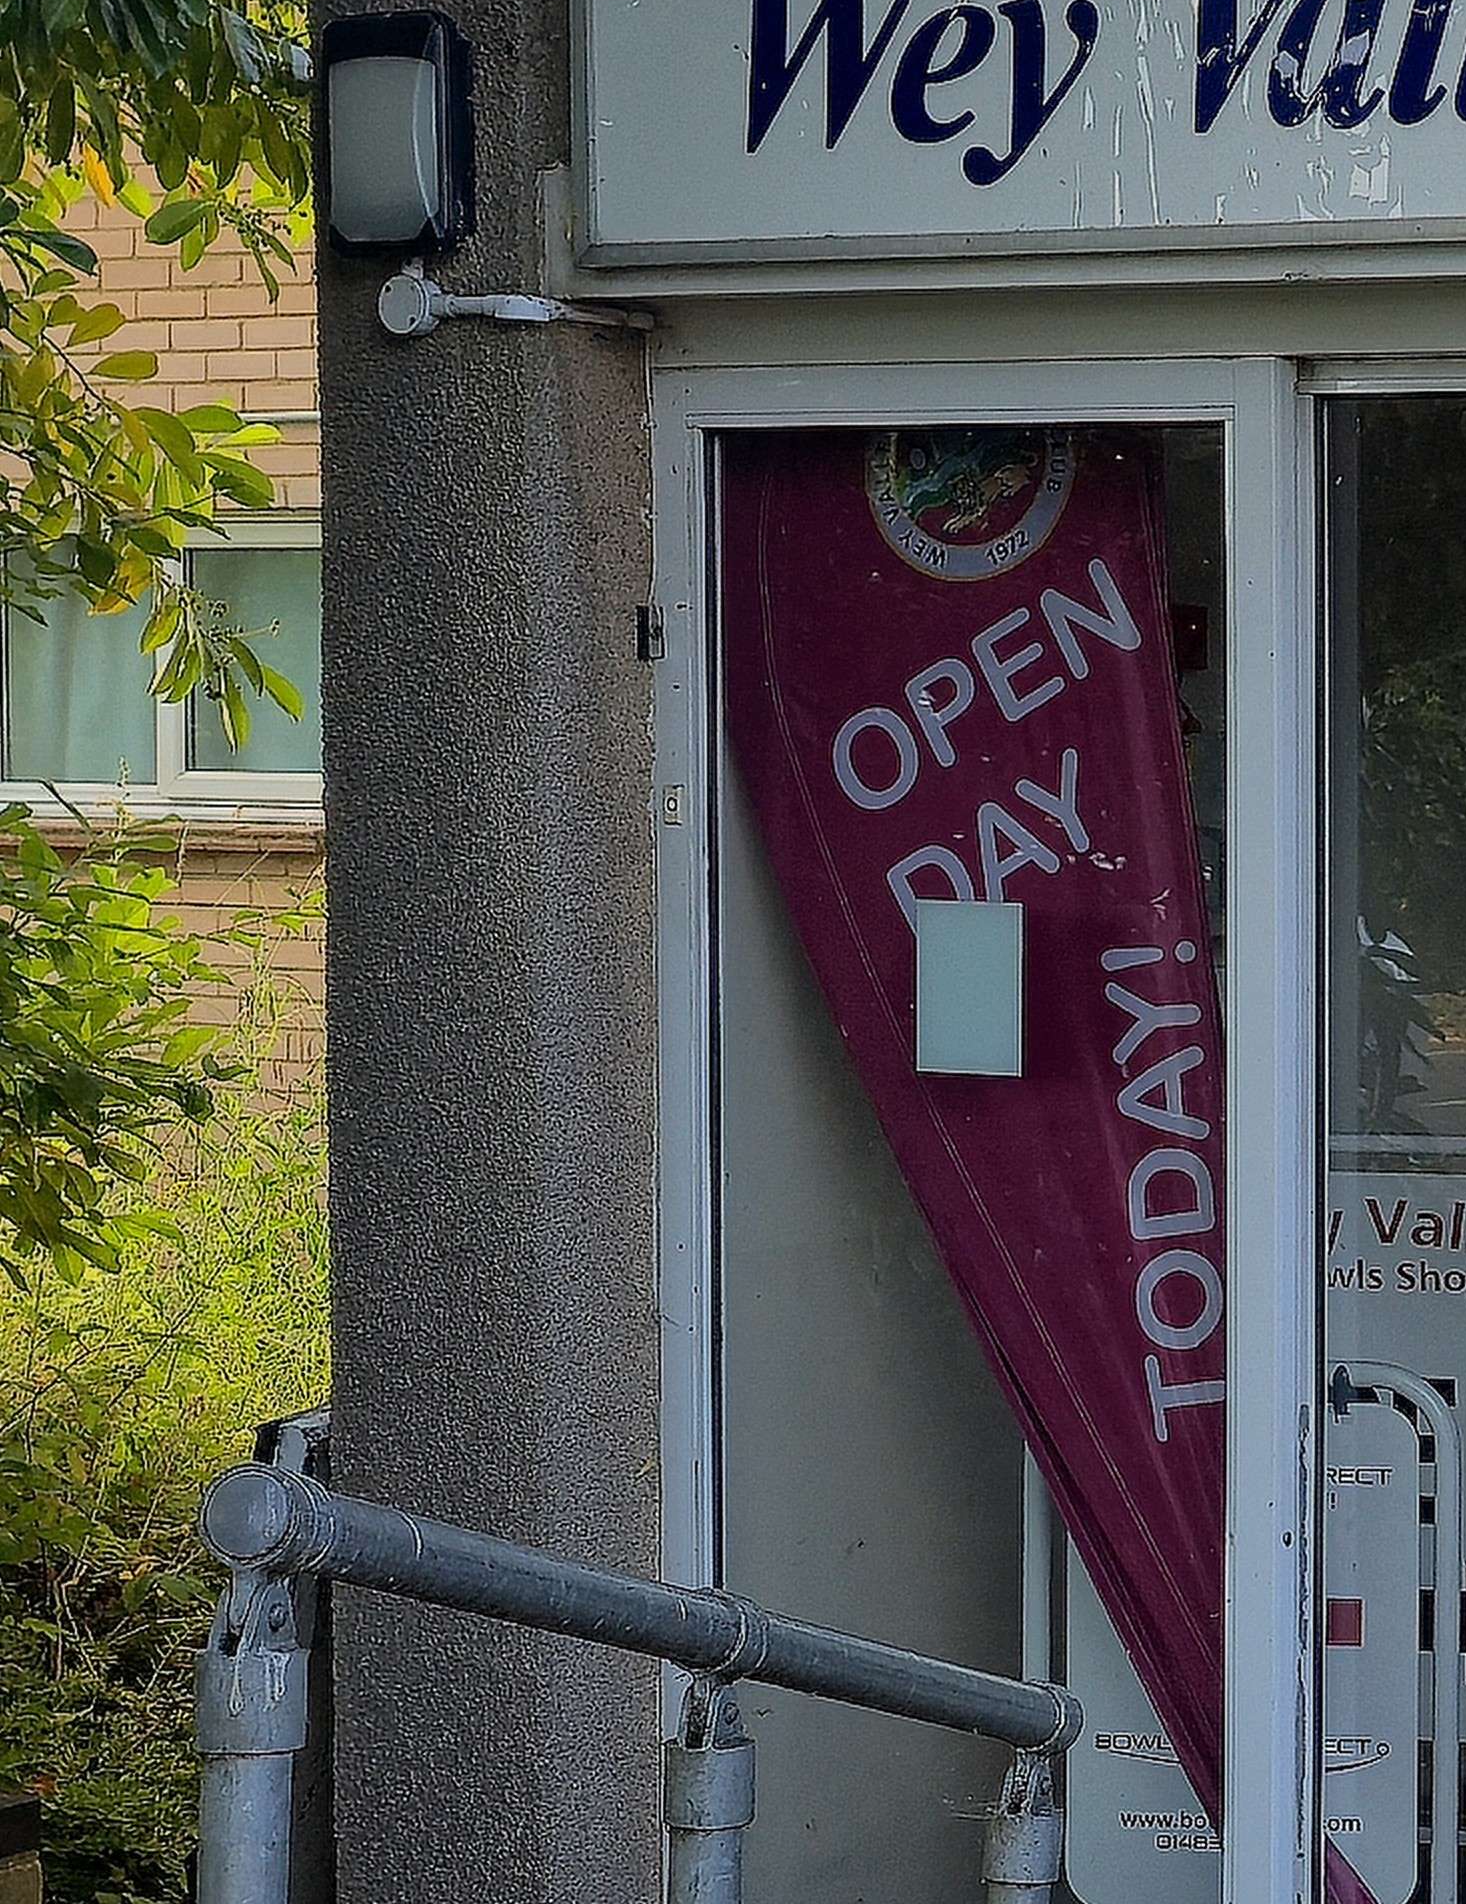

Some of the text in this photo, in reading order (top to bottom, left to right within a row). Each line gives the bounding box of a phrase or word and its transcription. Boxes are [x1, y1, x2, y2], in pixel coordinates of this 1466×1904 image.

[984, 529, 1030, 567] 1972
[832, 557, 1142, 811] OPEN
[885, 747, 1091, 938] DAY
[1100, 940, 1225, 1444] TODAY!
